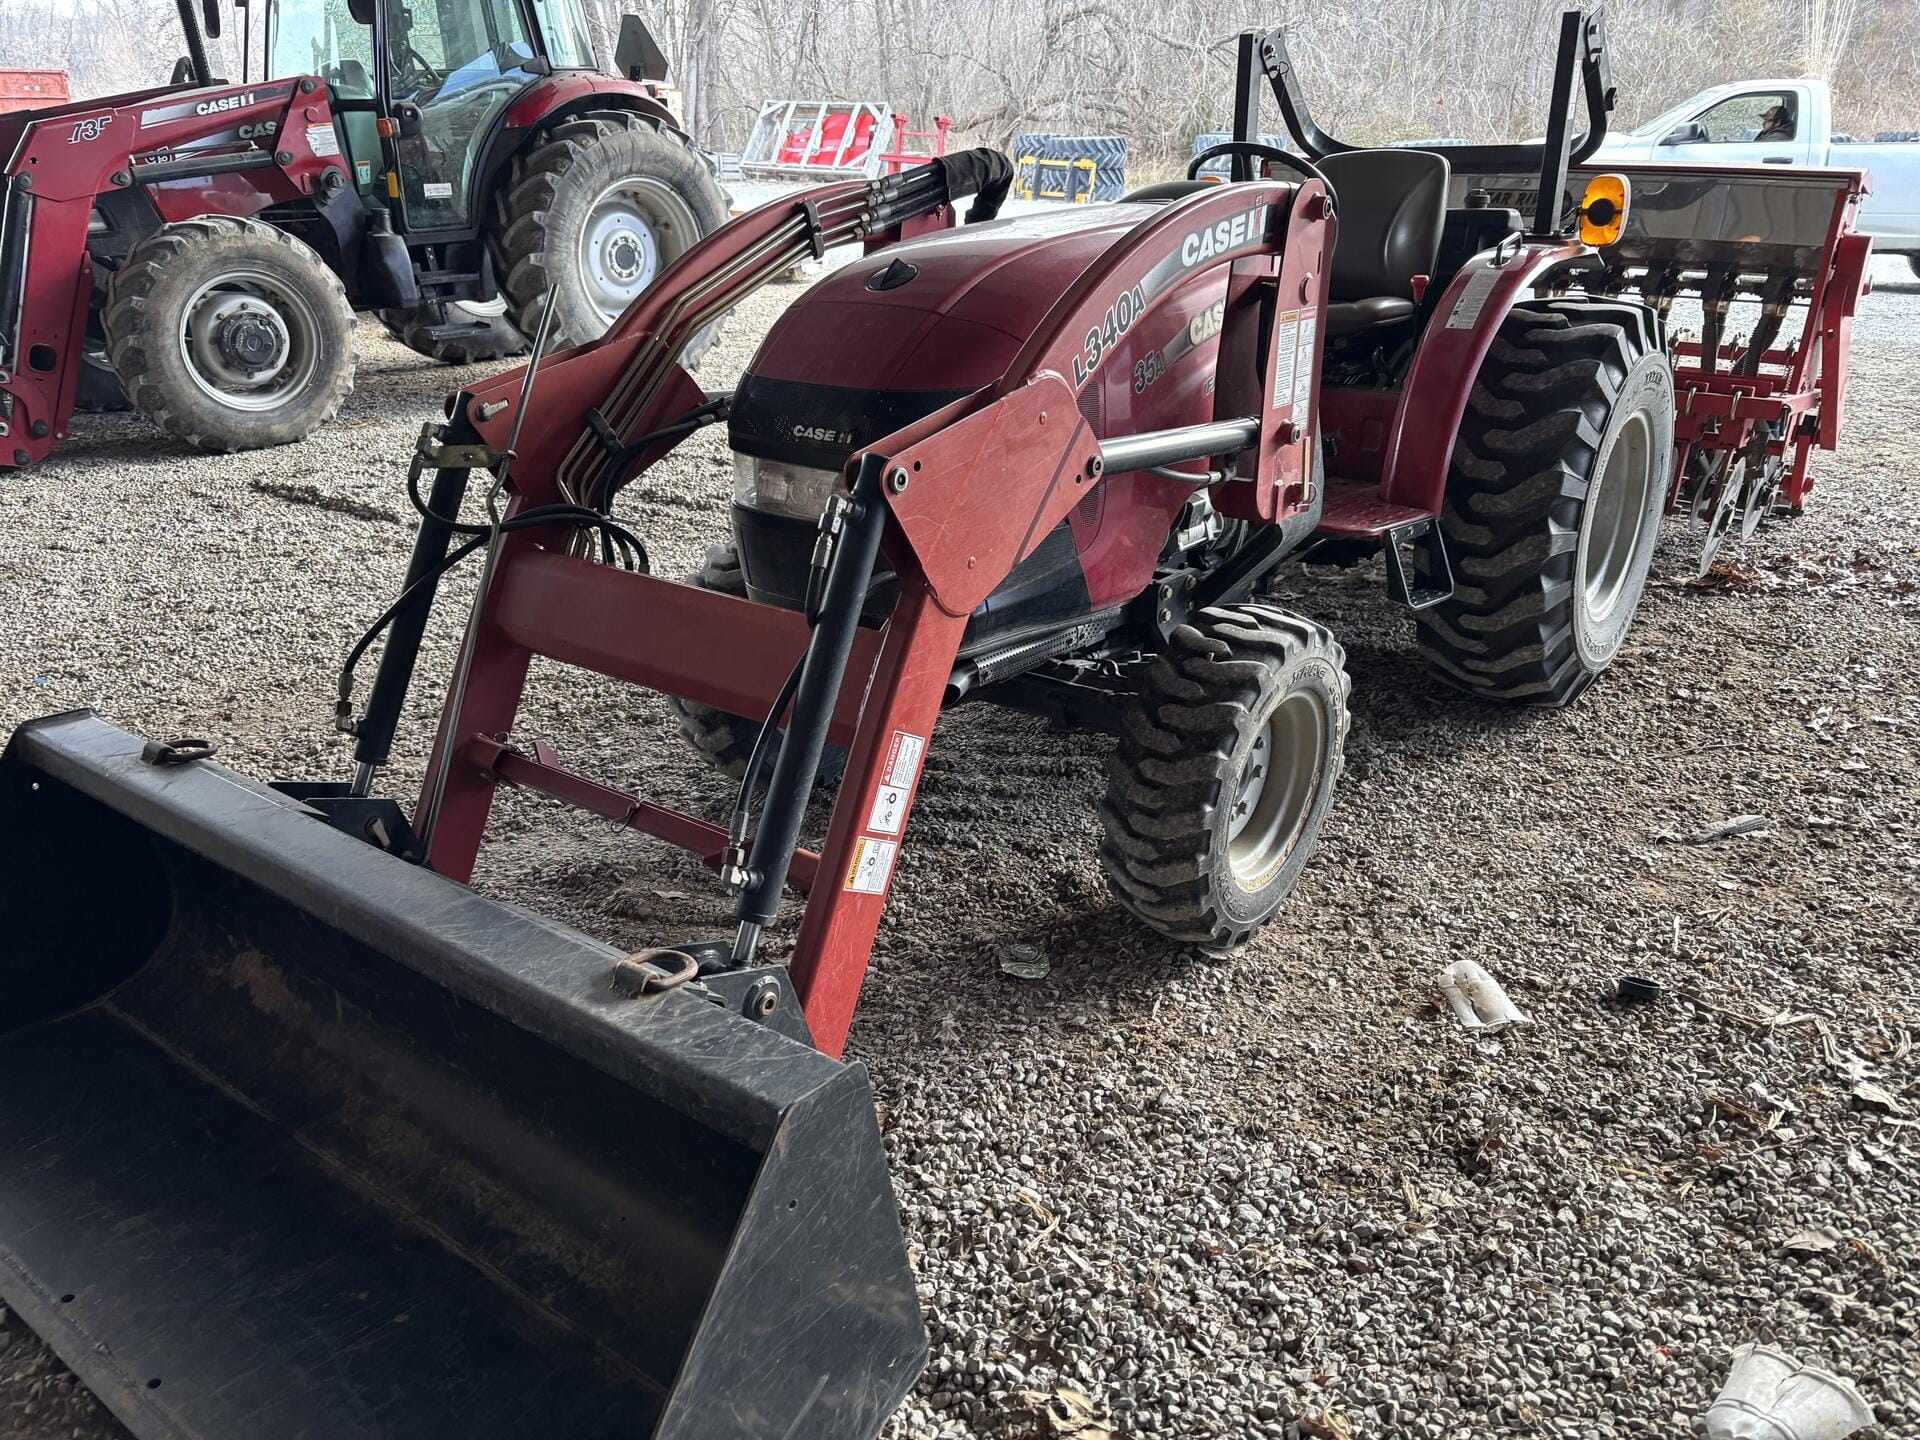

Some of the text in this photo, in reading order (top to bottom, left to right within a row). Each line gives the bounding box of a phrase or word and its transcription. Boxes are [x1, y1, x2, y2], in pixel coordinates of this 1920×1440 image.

[196, 96, 240, 116] CASE
[1182, 213, 1247, 267] CASE
[1072, 284, 1147, 390] L340A
[1133, 348, 1166, 394] 35A
[794, 425, 836, 441] CASE
[886, 737, 900, 772] DANGER
[852, 843, 864, 875] WARNING
